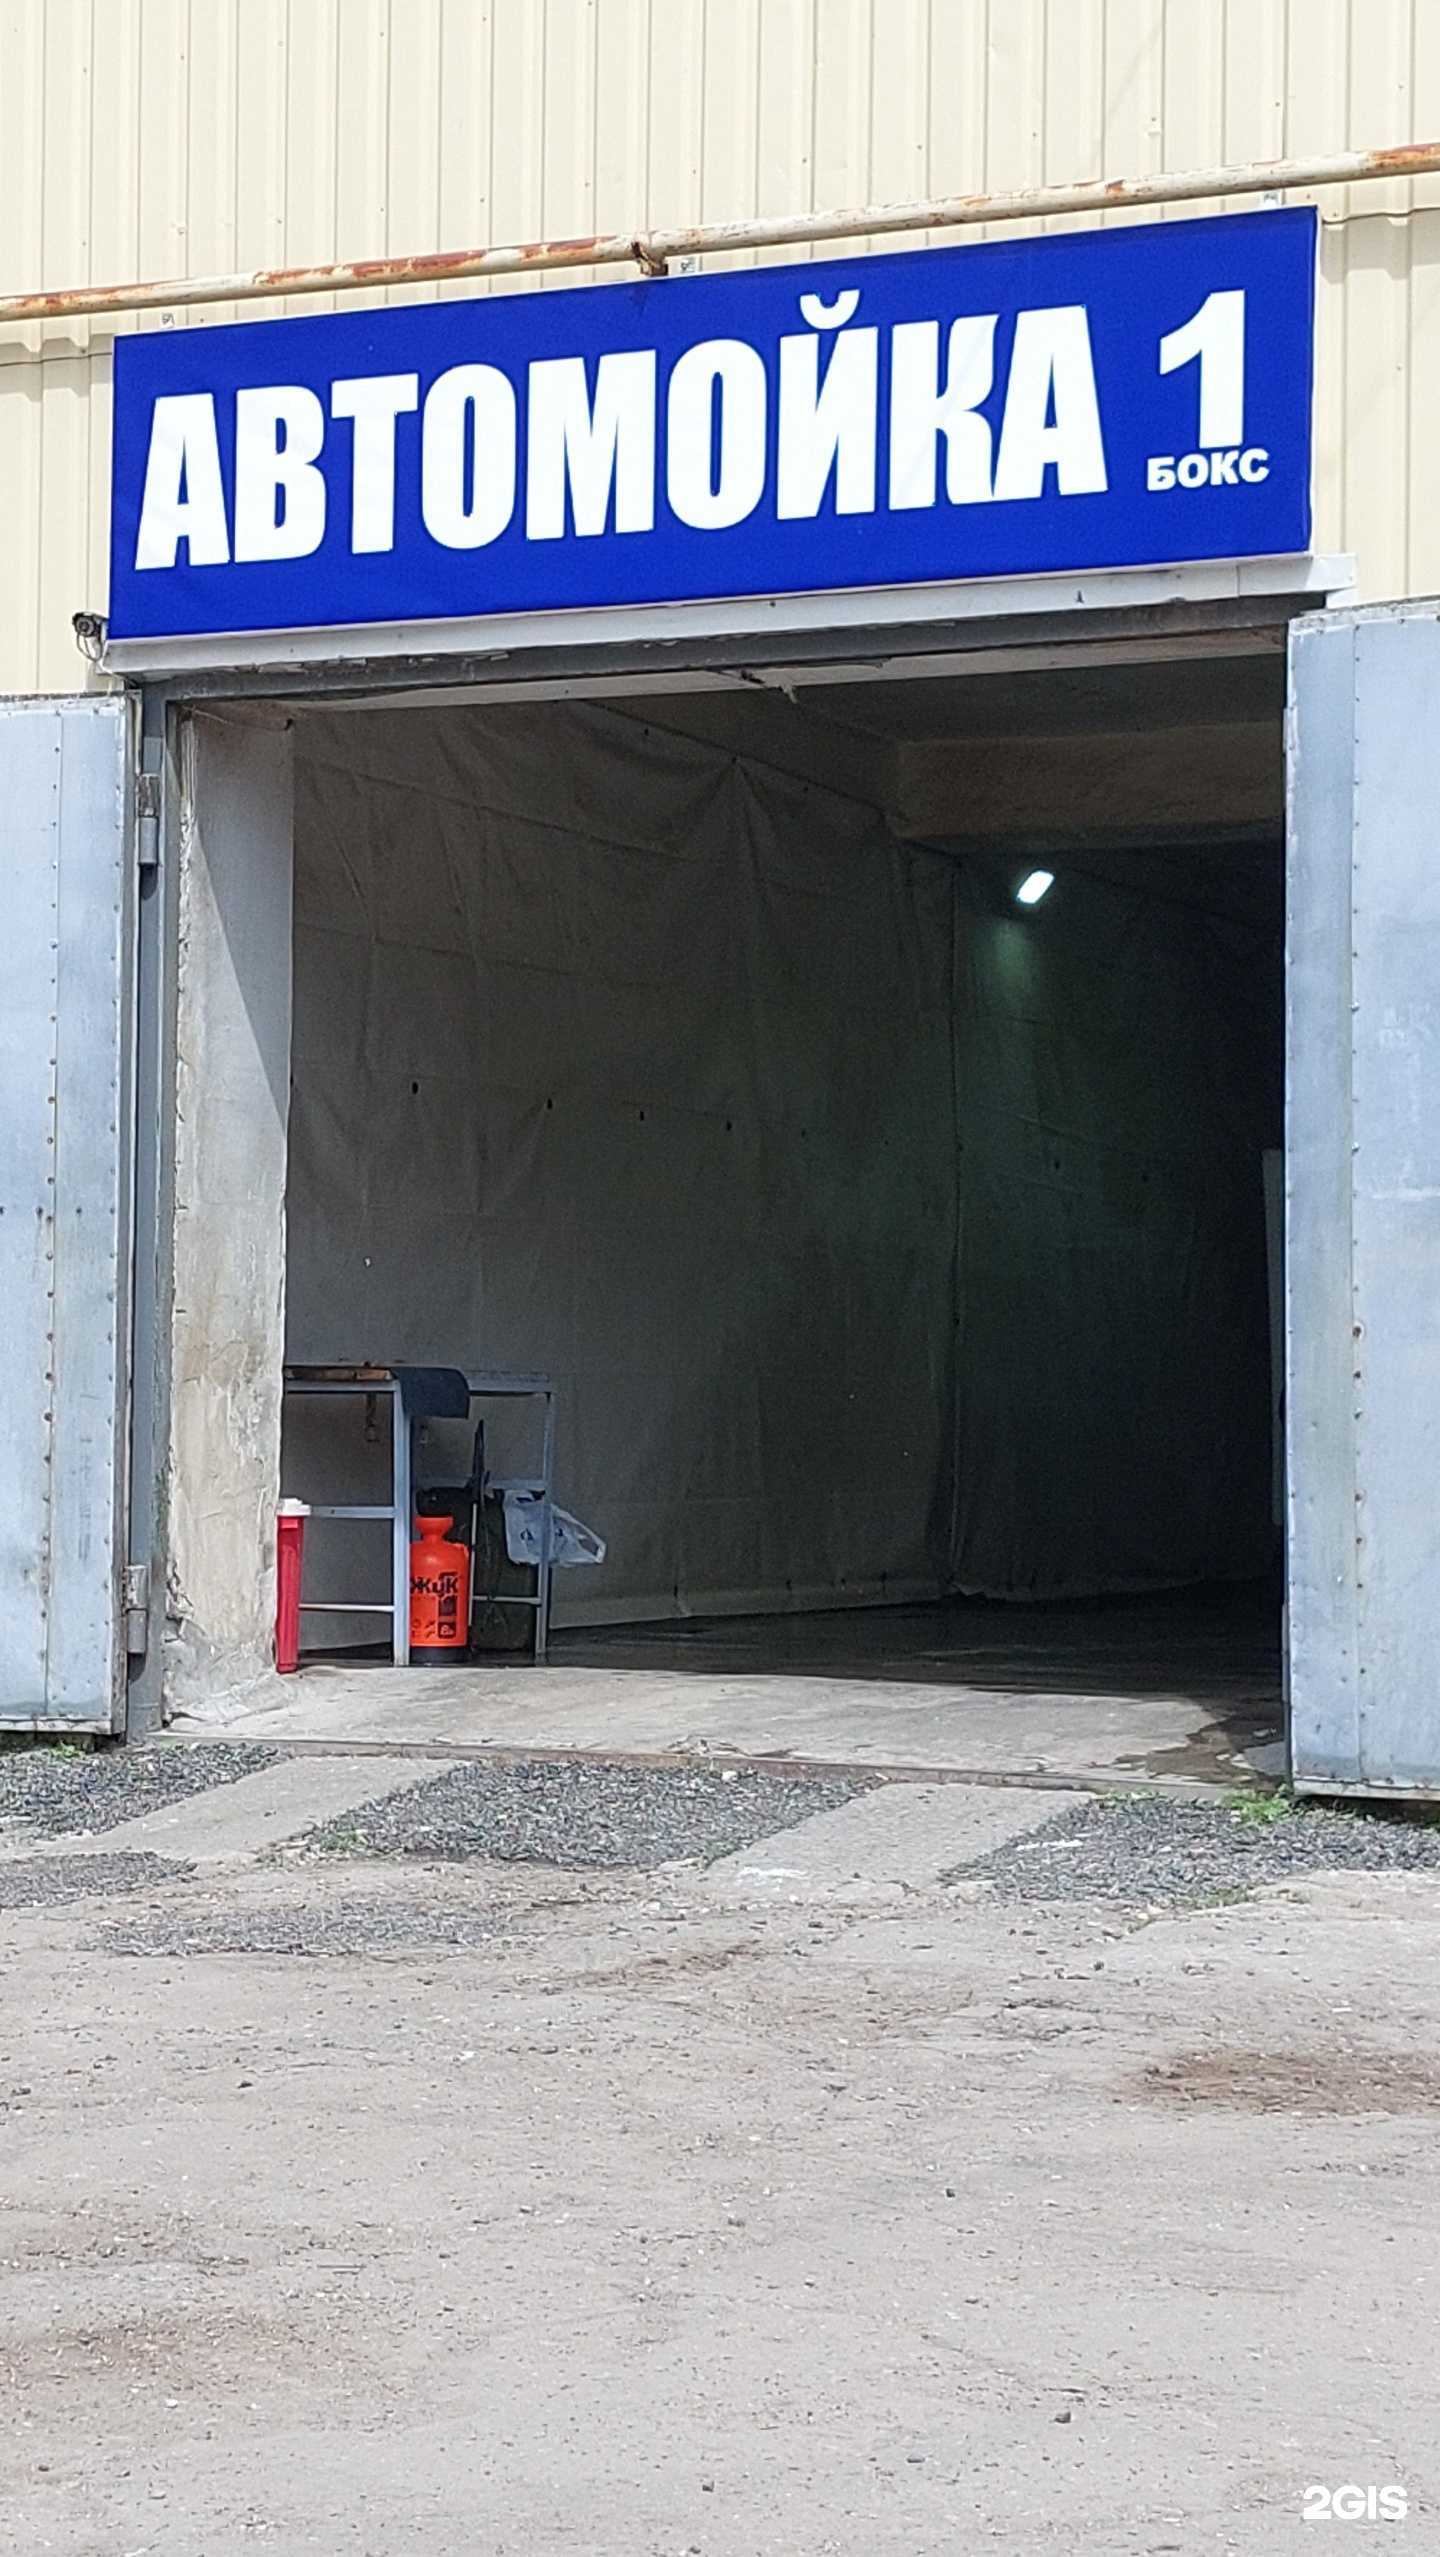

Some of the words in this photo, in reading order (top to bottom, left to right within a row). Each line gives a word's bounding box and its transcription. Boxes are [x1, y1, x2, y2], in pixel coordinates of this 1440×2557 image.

[136, 290, 1108, 570] АВТОМОЙКА
[1159, 290, 1245, 449] 1
[1147, 449, 1269, 491] БОКС
